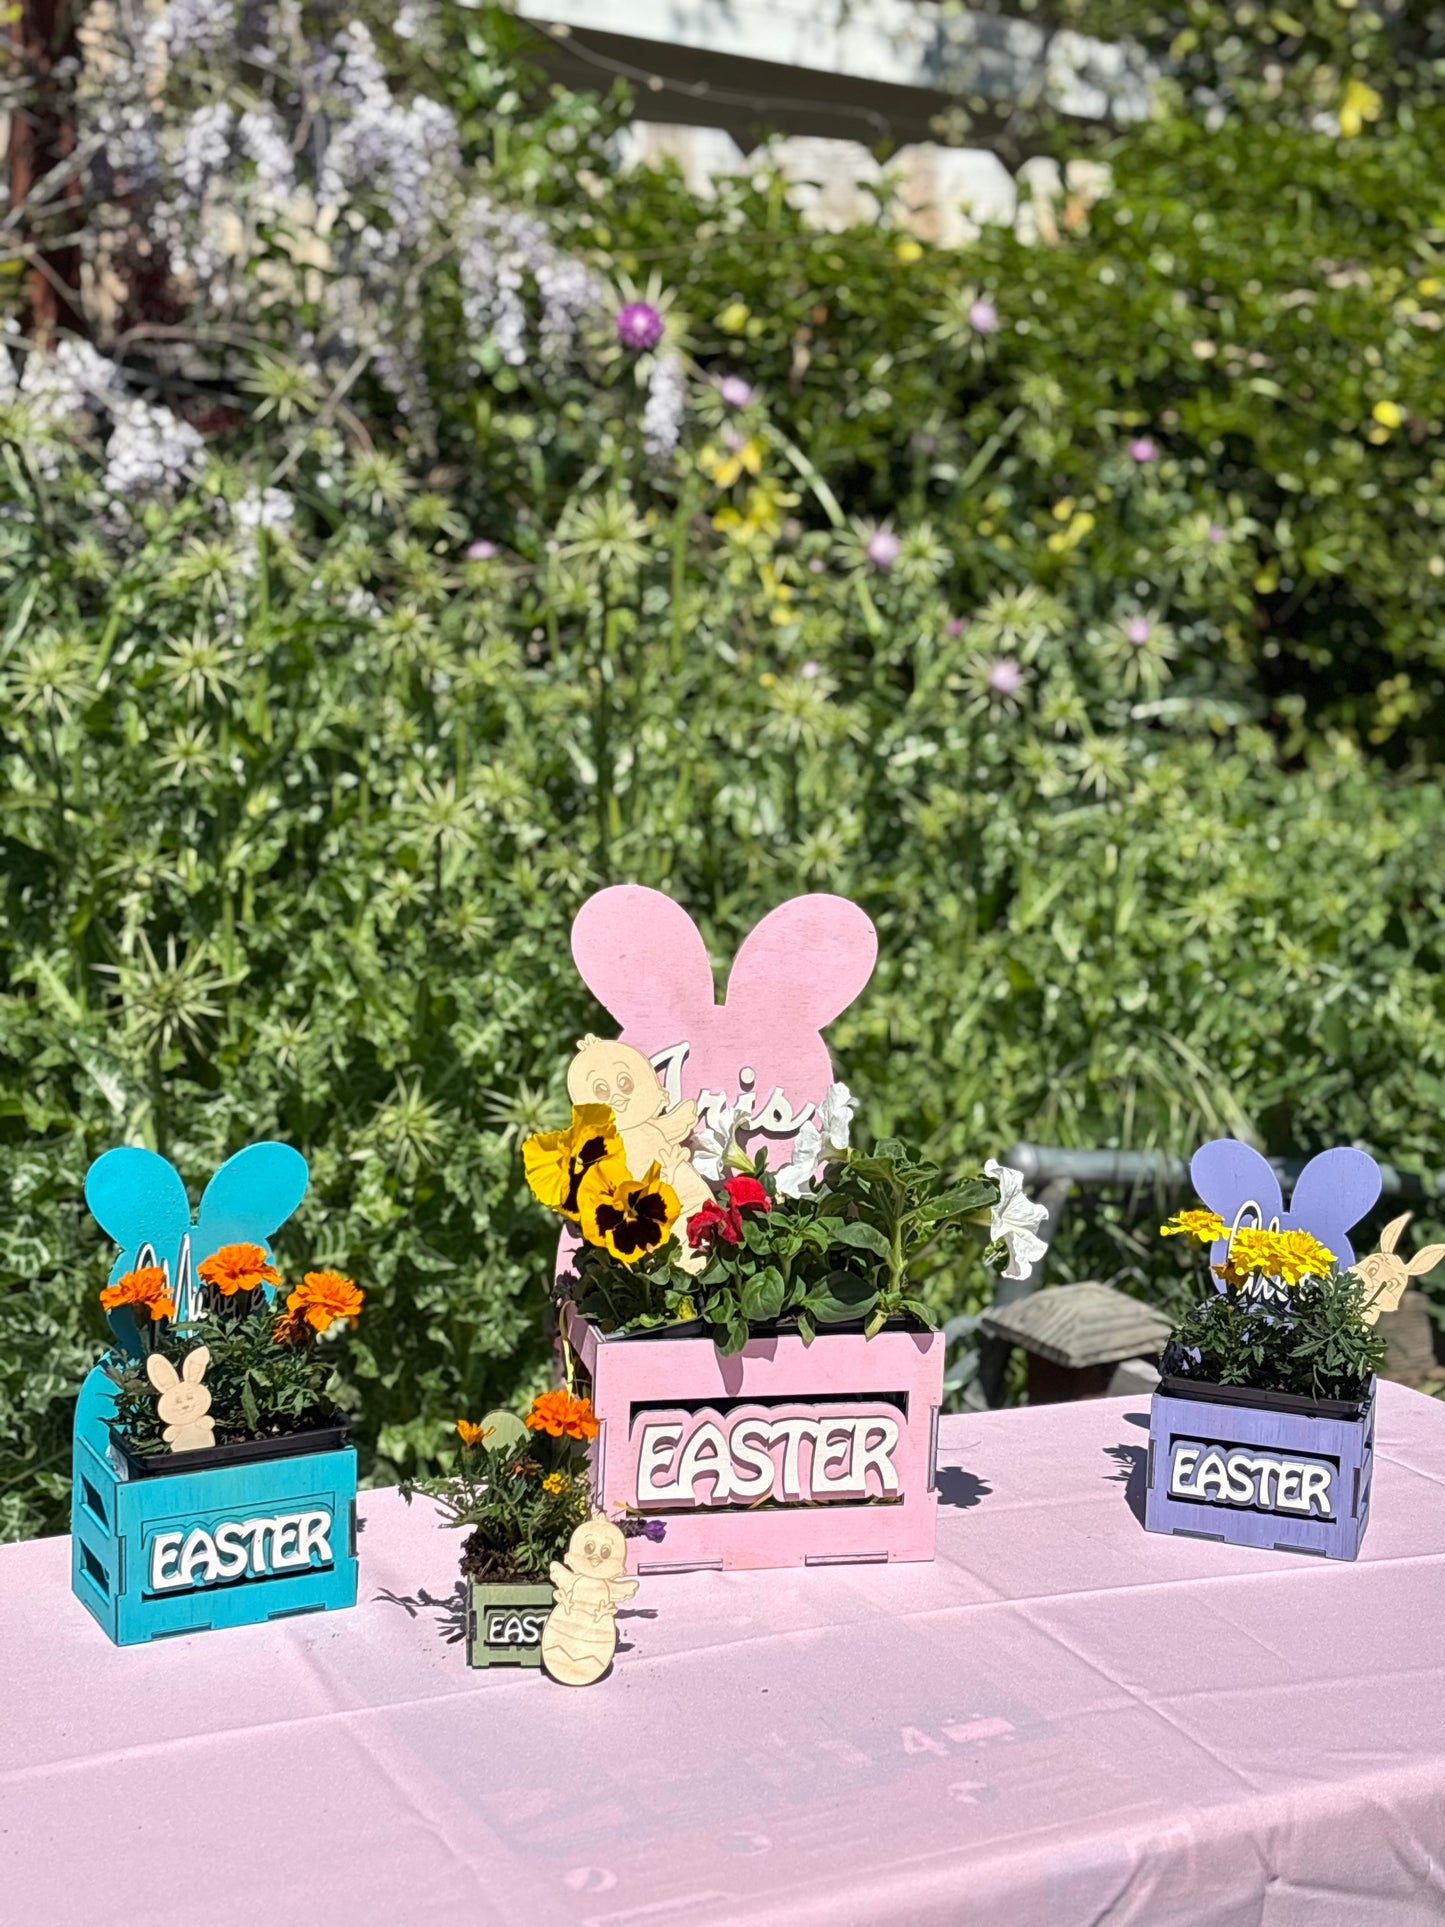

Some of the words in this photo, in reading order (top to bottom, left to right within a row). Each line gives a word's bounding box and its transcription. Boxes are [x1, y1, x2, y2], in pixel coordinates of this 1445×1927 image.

[650, 1040, 817, 1133] Iris
[134, 1232, 266, 1341] Michee
[636, 1416, 900, 1503] EASTER
[1171, 1447, 1332, 1515] EASTER
[151, 1509, 334, 1592] EASTER
[489, 1615, 547, 1644] EAS
